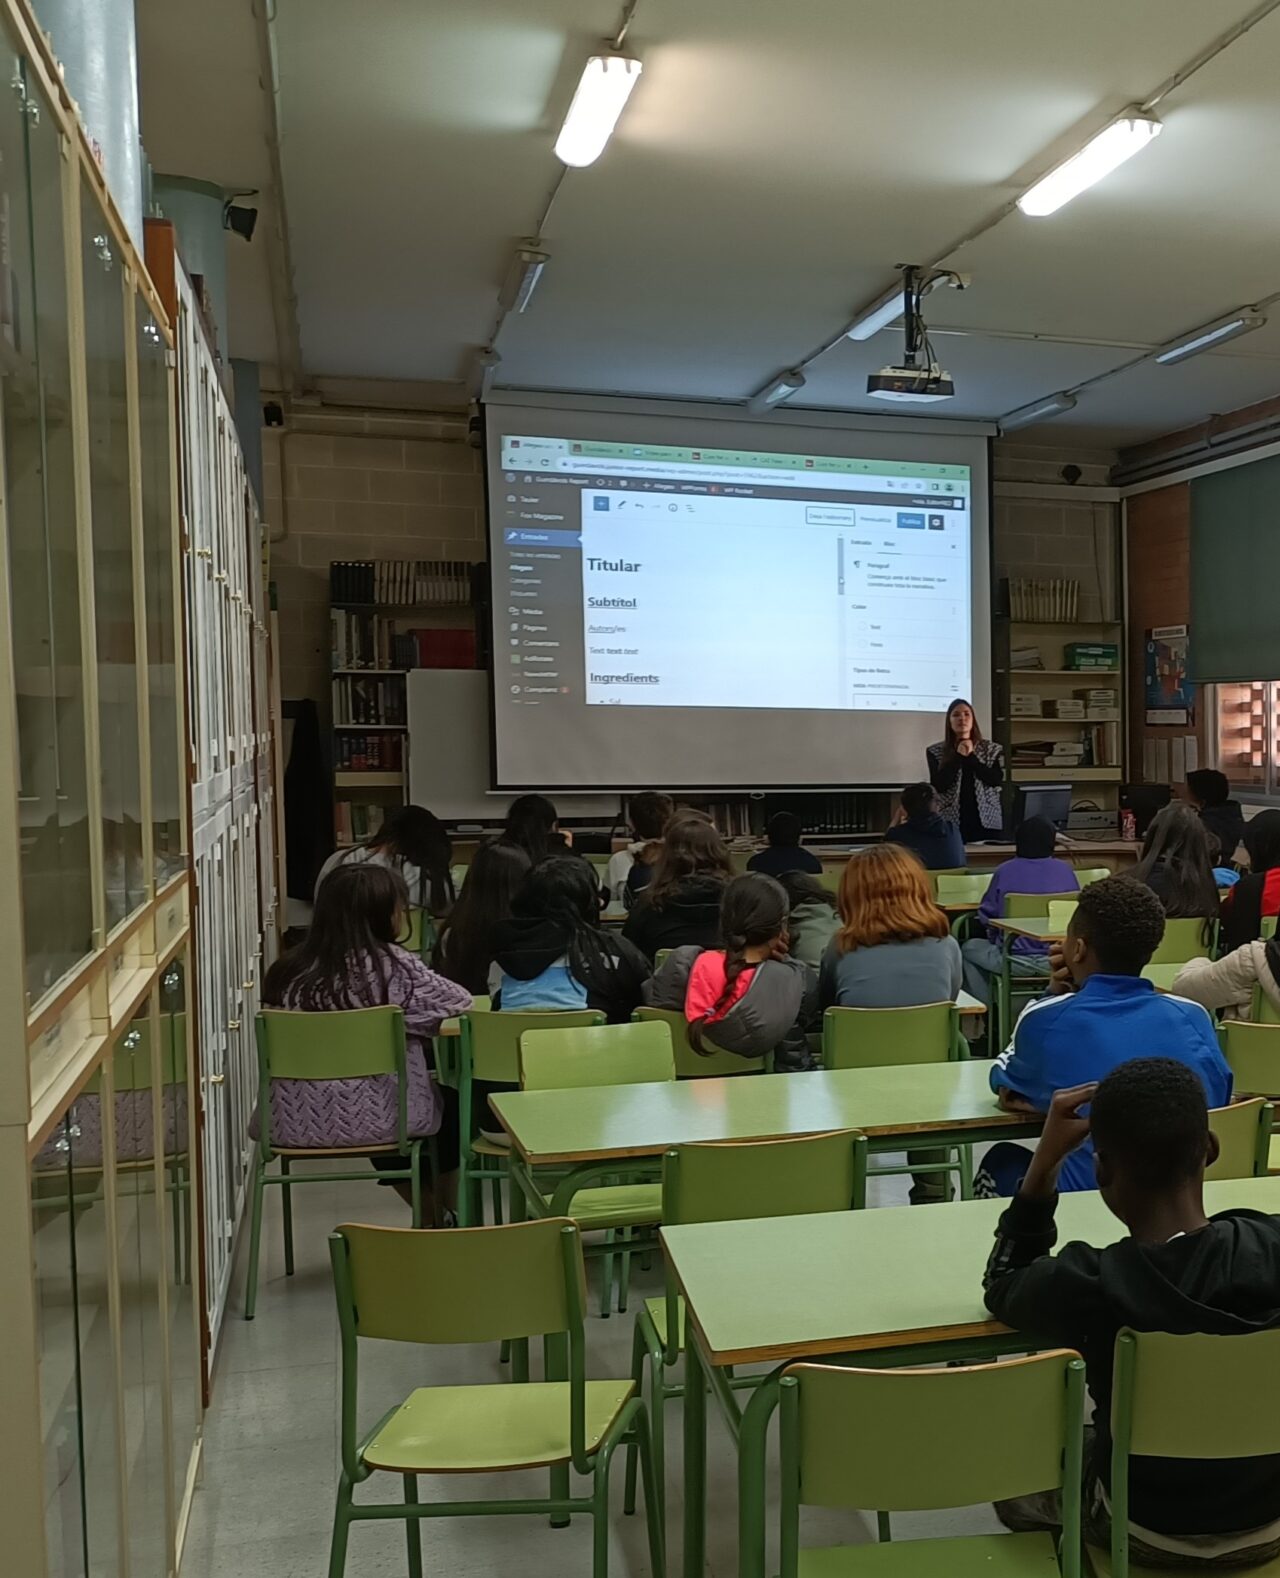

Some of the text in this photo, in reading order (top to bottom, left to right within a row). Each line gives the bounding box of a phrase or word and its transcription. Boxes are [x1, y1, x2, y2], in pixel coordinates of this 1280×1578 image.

[586, 558, 642, 572] Titular
[589, 646, 605, 655] Text
[590, 672, 660, 685] Ingredients
